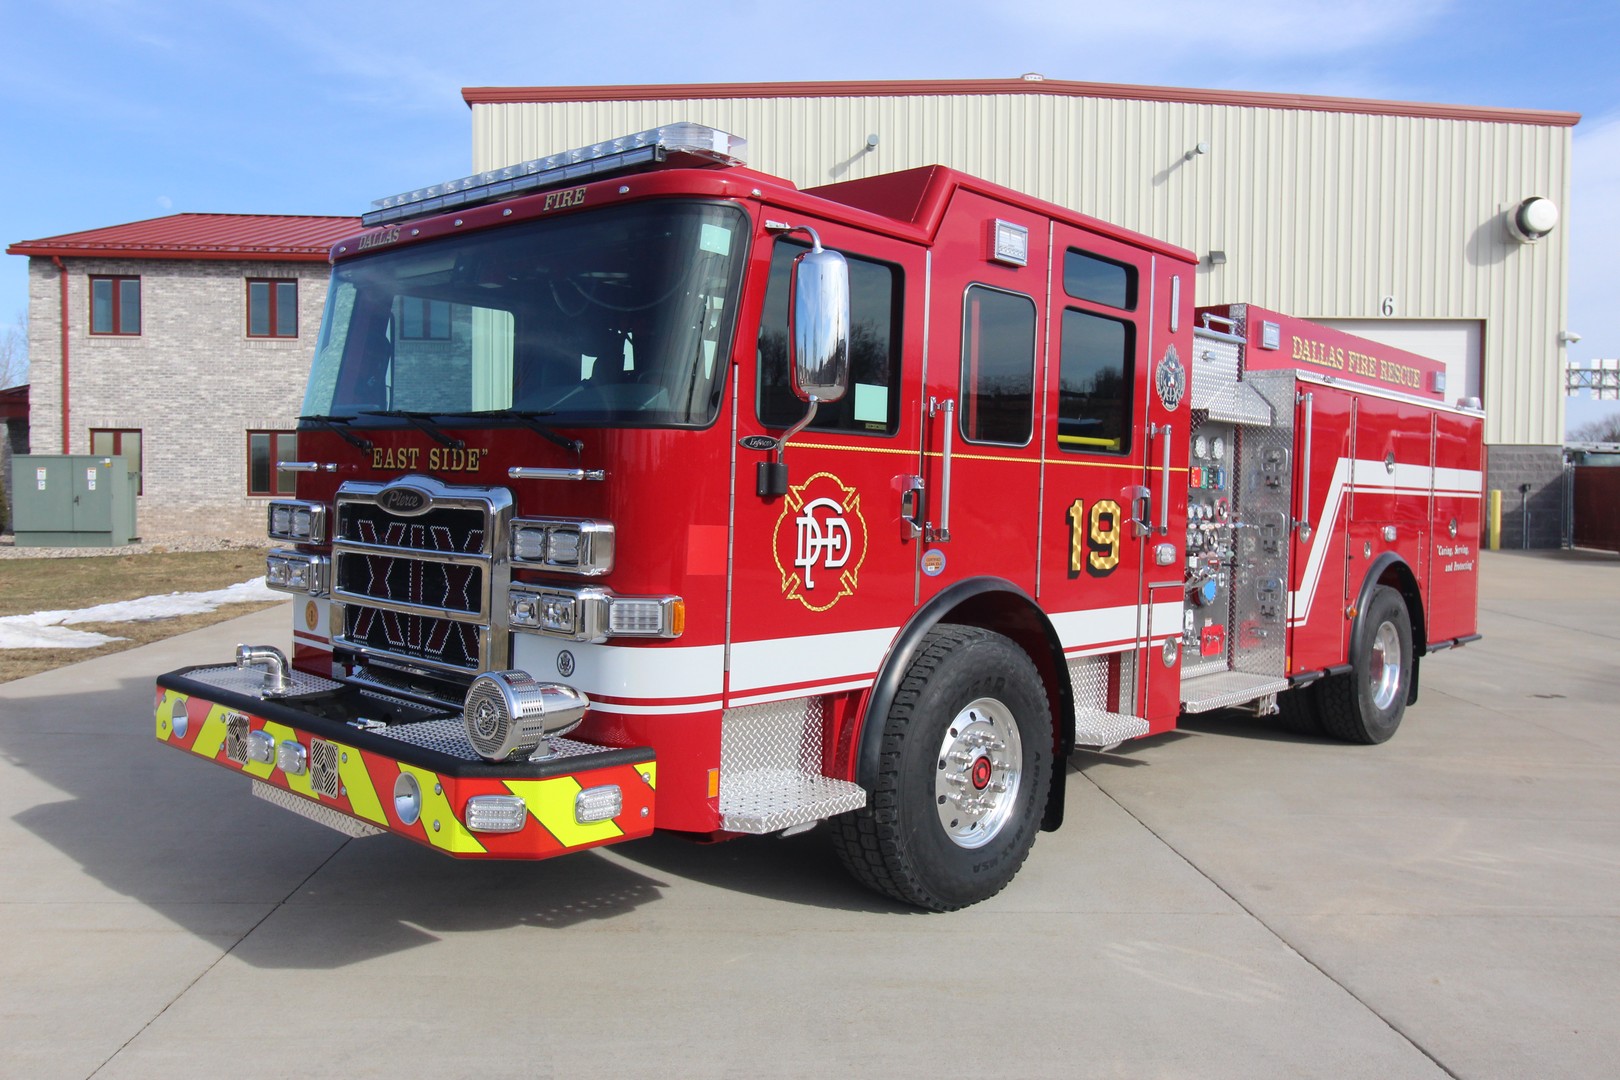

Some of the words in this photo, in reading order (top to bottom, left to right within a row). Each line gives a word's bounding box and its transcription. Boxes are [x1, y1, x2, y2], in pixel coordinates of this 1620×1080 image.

[357, 228, 401, 251] DALLAS
[543, 187, 588, 212] FIRE
[1381, 296, 1394, 317] 6
[1291, 335, 1345, 371] DALLAS
[1347, 350, 1378, 380] FIRE
[1379, 359, 1421, 390] RESCUE
[387, 489, 419, 508] Pierce
[1065, 498, 1121, 580] 19
